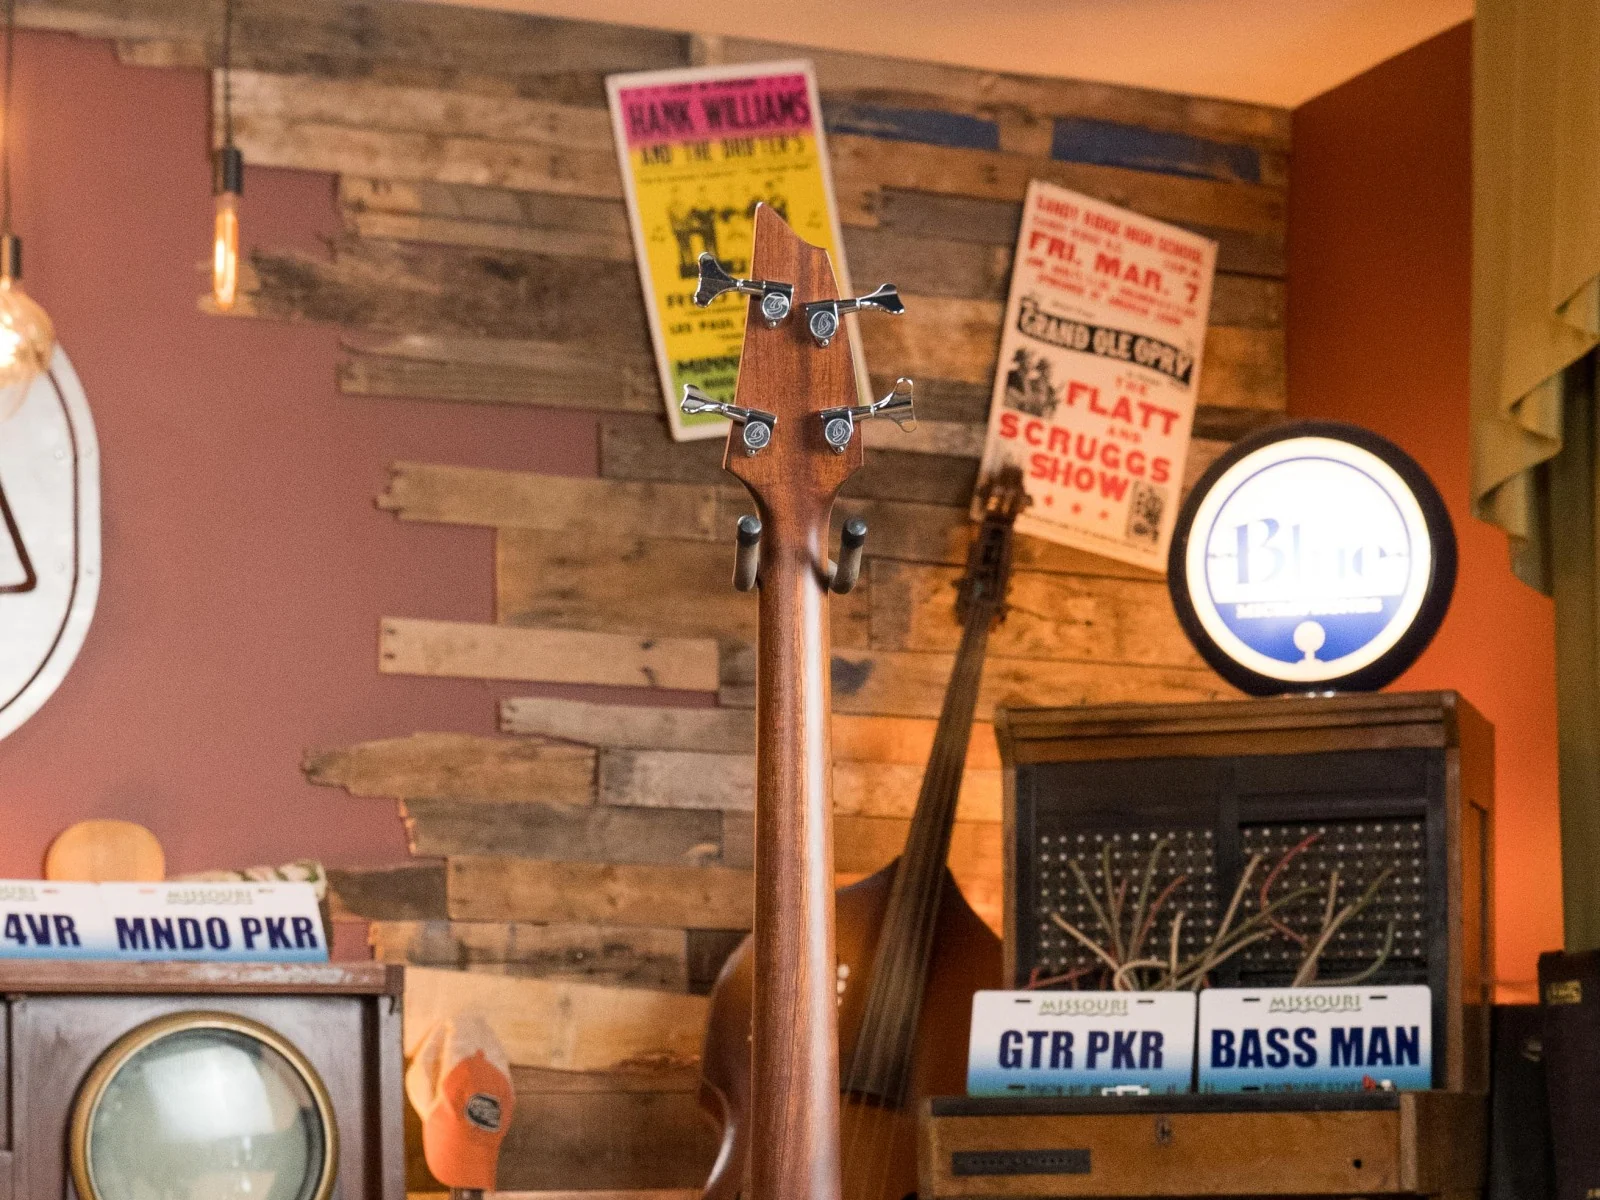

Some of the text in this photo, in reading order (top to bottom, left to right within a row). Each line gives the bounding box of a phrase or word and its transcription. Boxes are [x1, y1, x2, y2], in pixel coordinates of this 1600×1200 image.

[628, 88, 812, 137] HANK WILLIAMS
[1028, 230, 1081, 266] FRI.
[1094, 252, 1170, 295] MAR.
[1184, 281, 1198, 304] 7
[1020, 298, 1091, 351] GRAND
[1093, 325, 1132, 360] OLE
[1133, 335, 1194, 385] OPRY
[1067, 380, 1181, 437] FLATT
[1000, 411, 1171, 484] SCRUGGS
[1030, 453, 1130, 503] SHOW
[4, 912, 82, 946] 4VR
[115, 916, 318, 950] MNDO PKR
[1039, 998, 1129, 1014] MISSOURI
[1270, 995, 1361, 1011] MISSOURI
[998, 1029, 1165, 1070] GTR PKR
[1211, 1025, 1420, 1069] BASS MAN
